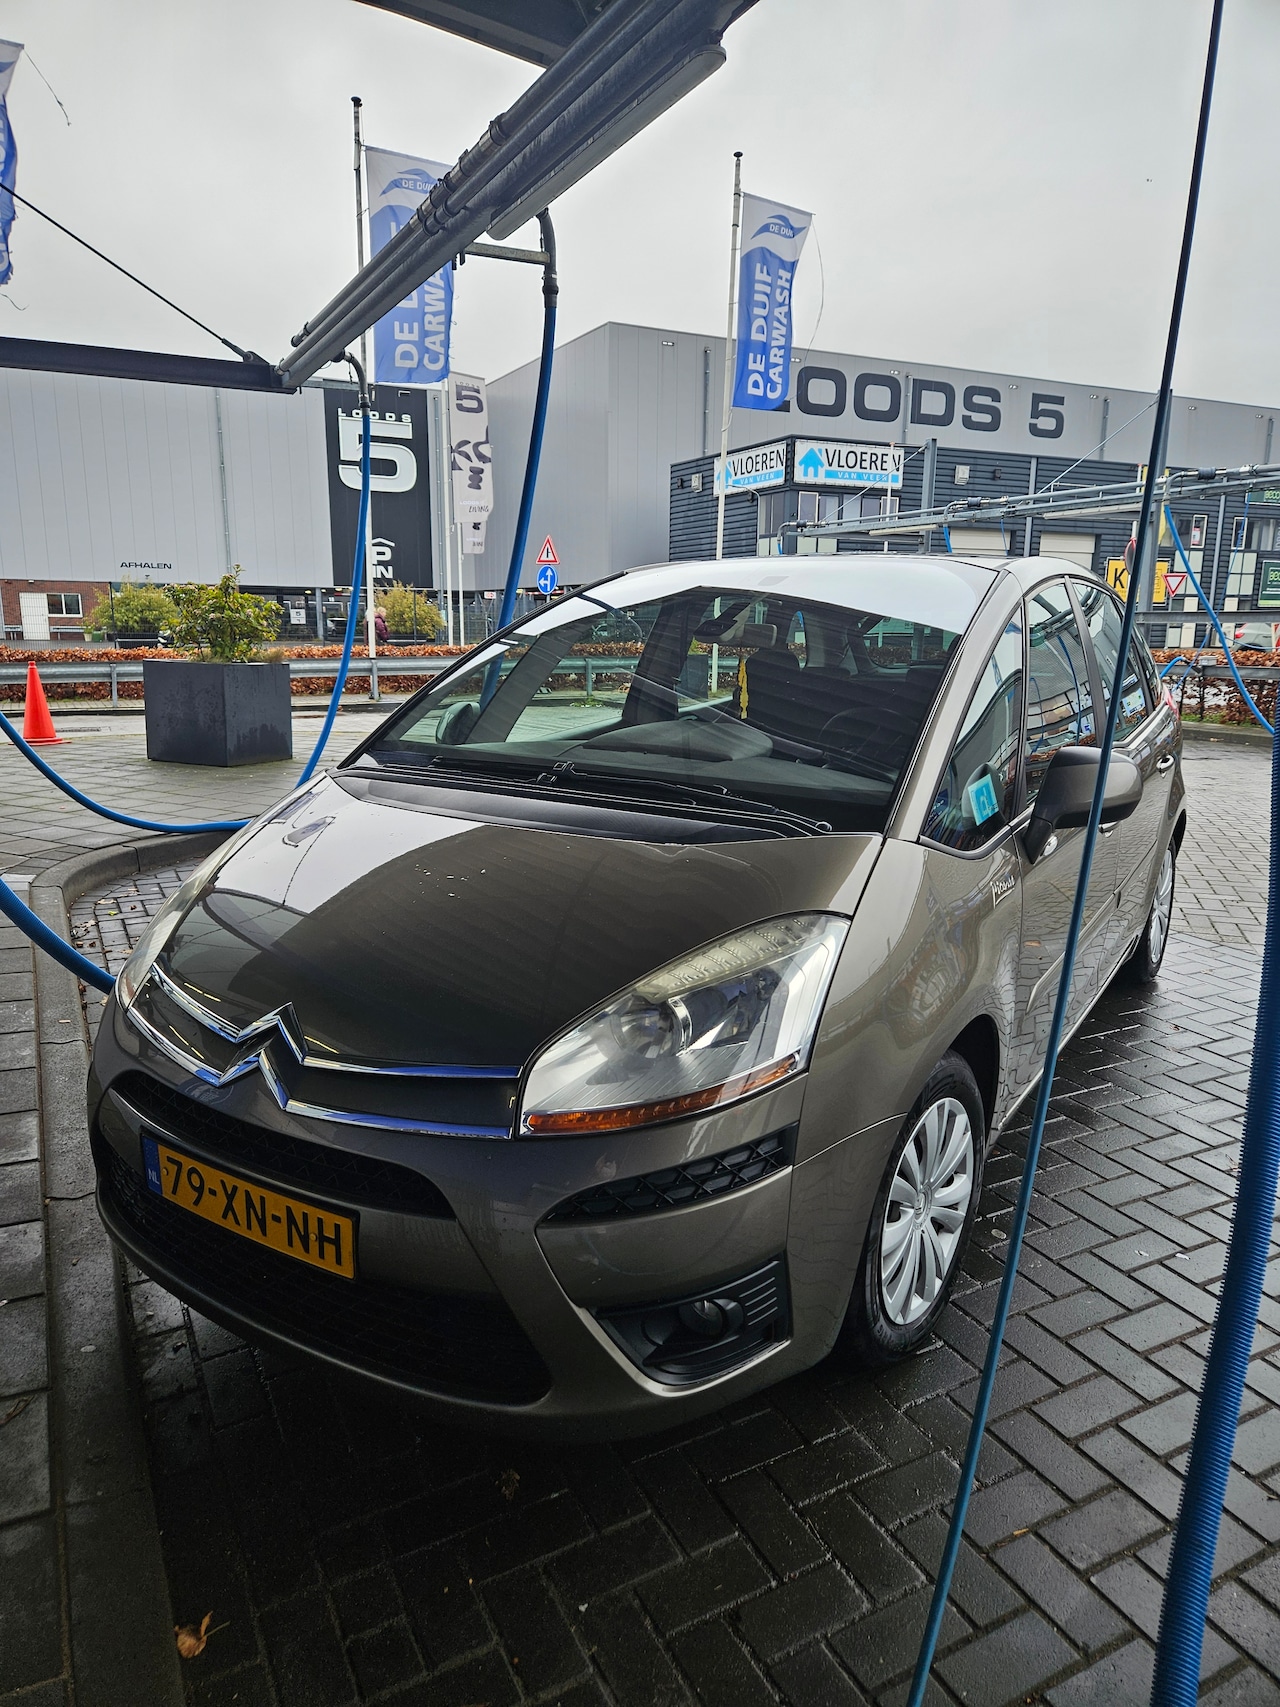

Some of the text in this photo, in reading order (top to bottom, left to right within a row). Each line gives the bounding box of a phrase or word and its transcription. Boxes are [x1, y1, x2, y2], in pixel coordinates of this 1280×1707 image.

[402, 180, 434, 192] DE DUI
[770, 223, 780, 233] DE
[422, 263, 446, 371] CARWA
[747, 262, 773, 396] DE DUIF
[394, 320, 420, 369] DE
[766, 268, 792, 400] CARWASH
[455, 384, 484, 414] 5
[772, 365, 1066, 439] OODS 5
[338, 407, 413, 423] LOODS
[337, 416, 418, 493] 5
[732, 449, 786, 477] VLOEREN
[739, 472, 775, 485] VAN VEEN
[837, 471, 888, 482] VAN VEEN
[120, 561, 173, 570] AFHALEN
[147, 1168, 160, 1185] NL
[166, 1155, 342, 1267] 79-XN-NH
